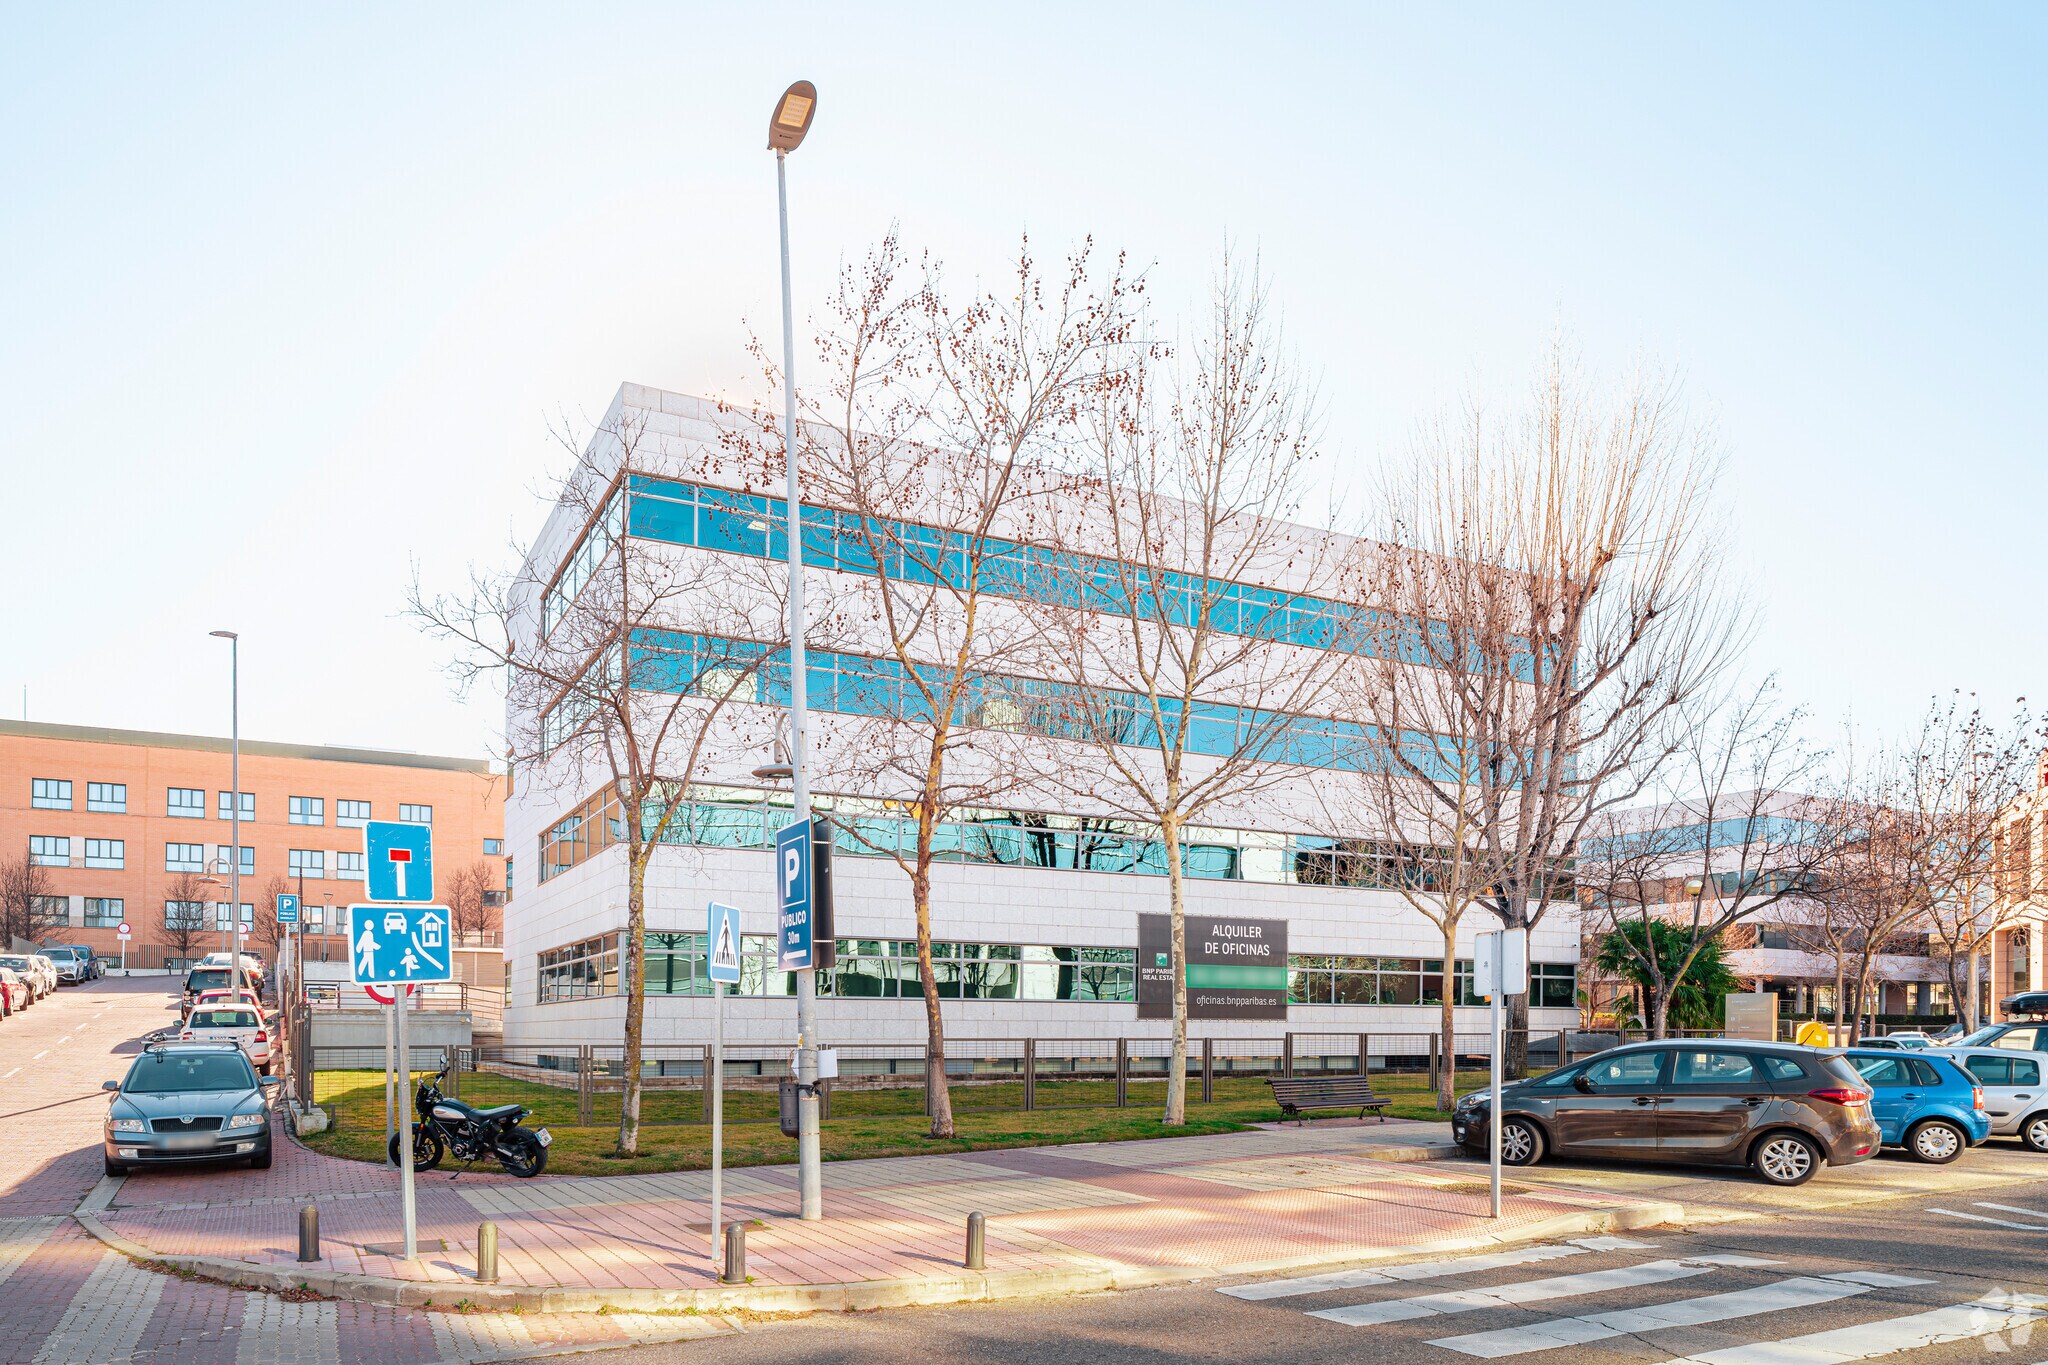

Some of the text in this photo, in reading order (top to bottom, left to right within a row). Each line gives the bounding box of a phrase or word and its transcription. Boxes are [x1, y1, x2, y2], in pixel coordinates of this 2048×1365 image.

[785, 848, 799, 898] P
[283, 899, 292, 909] P
[781, 910, 806, 928] PÚBLICO
[788, 931, 800, 945] 30m
[1212, 924, 1262, 940] ALQUILER
[1204, 942, 1270, 956] DE OFICINAS
[1196, 995, 1277, 1007] oficinas.bnpparibas.es
